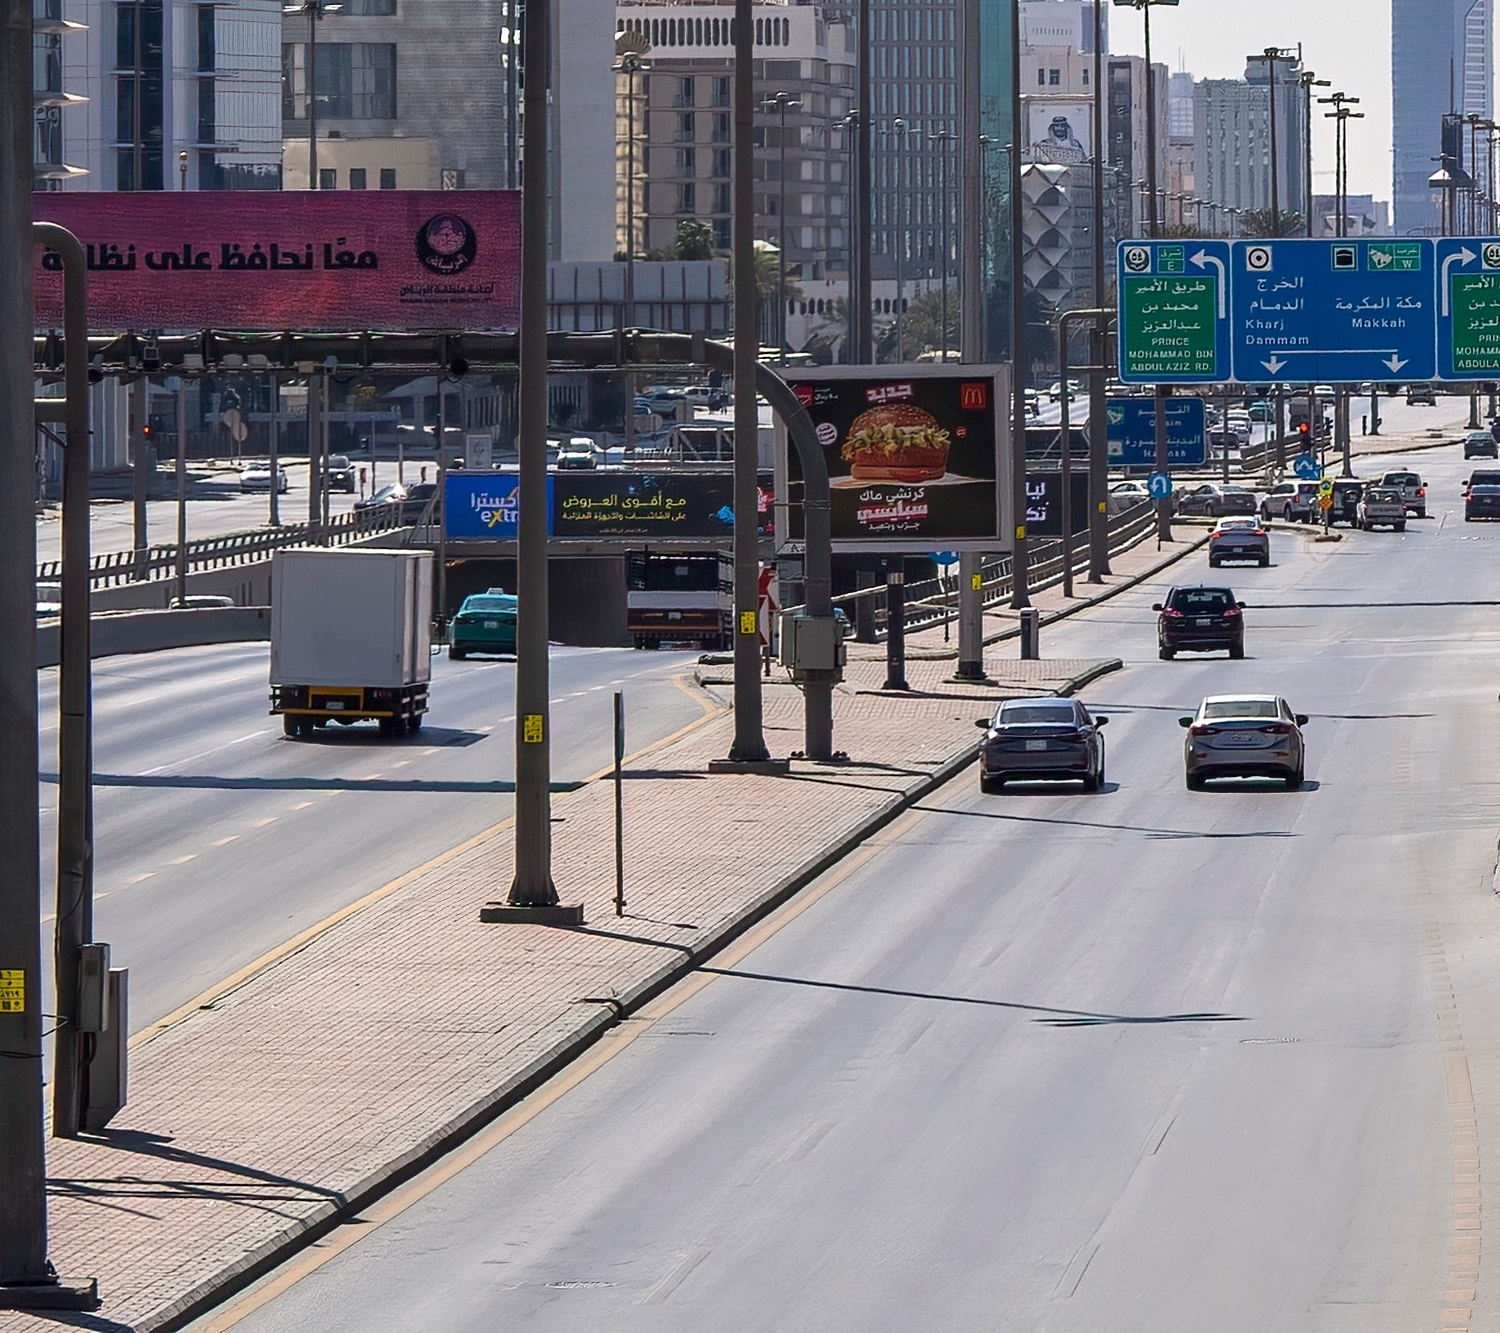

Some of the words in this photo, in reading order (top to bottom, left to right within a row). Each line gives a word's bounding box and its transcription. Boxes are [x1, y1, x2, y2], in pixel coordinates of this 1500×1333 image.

[41, 244, 136, 271] نظاة
[145, 243, 213, 271] على
[217, 243, 314, 270] نحافظ
[1402, 259, 1413, 269] W
[1135, 278, 1167, 294] الأمير
[1171, 280, 1206, 294] طريق
[1257, 276, 1304, 292] الخرج
[1462, 274, 1494, 291] الأمير
[1141, 302, 1158, 313] بن
[1162, 301, 1198, 311] محمد
[1250, 298, 1304, 314] الدمام
[1335, 296, 1390, 313] المكرمة
[1396, 296, 1422, 309] مكة
[1468, 299, 1485, 310] بن
[1142, 319, 1201, 333] عبدالعزيز
[1245, 318, 1284, 330] Kharj
[1352, 317, 1405, 328] Makkah
[1151, 337, 1189, 345] PRINCE
[1245, 334, 1309, 345] Dammam
[1129, 350, 1191, 358] MOHAMMAD
[1196, 349, 1213, 358] BIN
[1131, 363, 1191, 371] ABDULAZIZ
[562, 494, 618, 509] العروض
[622, 490, 663, 509] أقوى
[665, 497, 687, 509] مع
